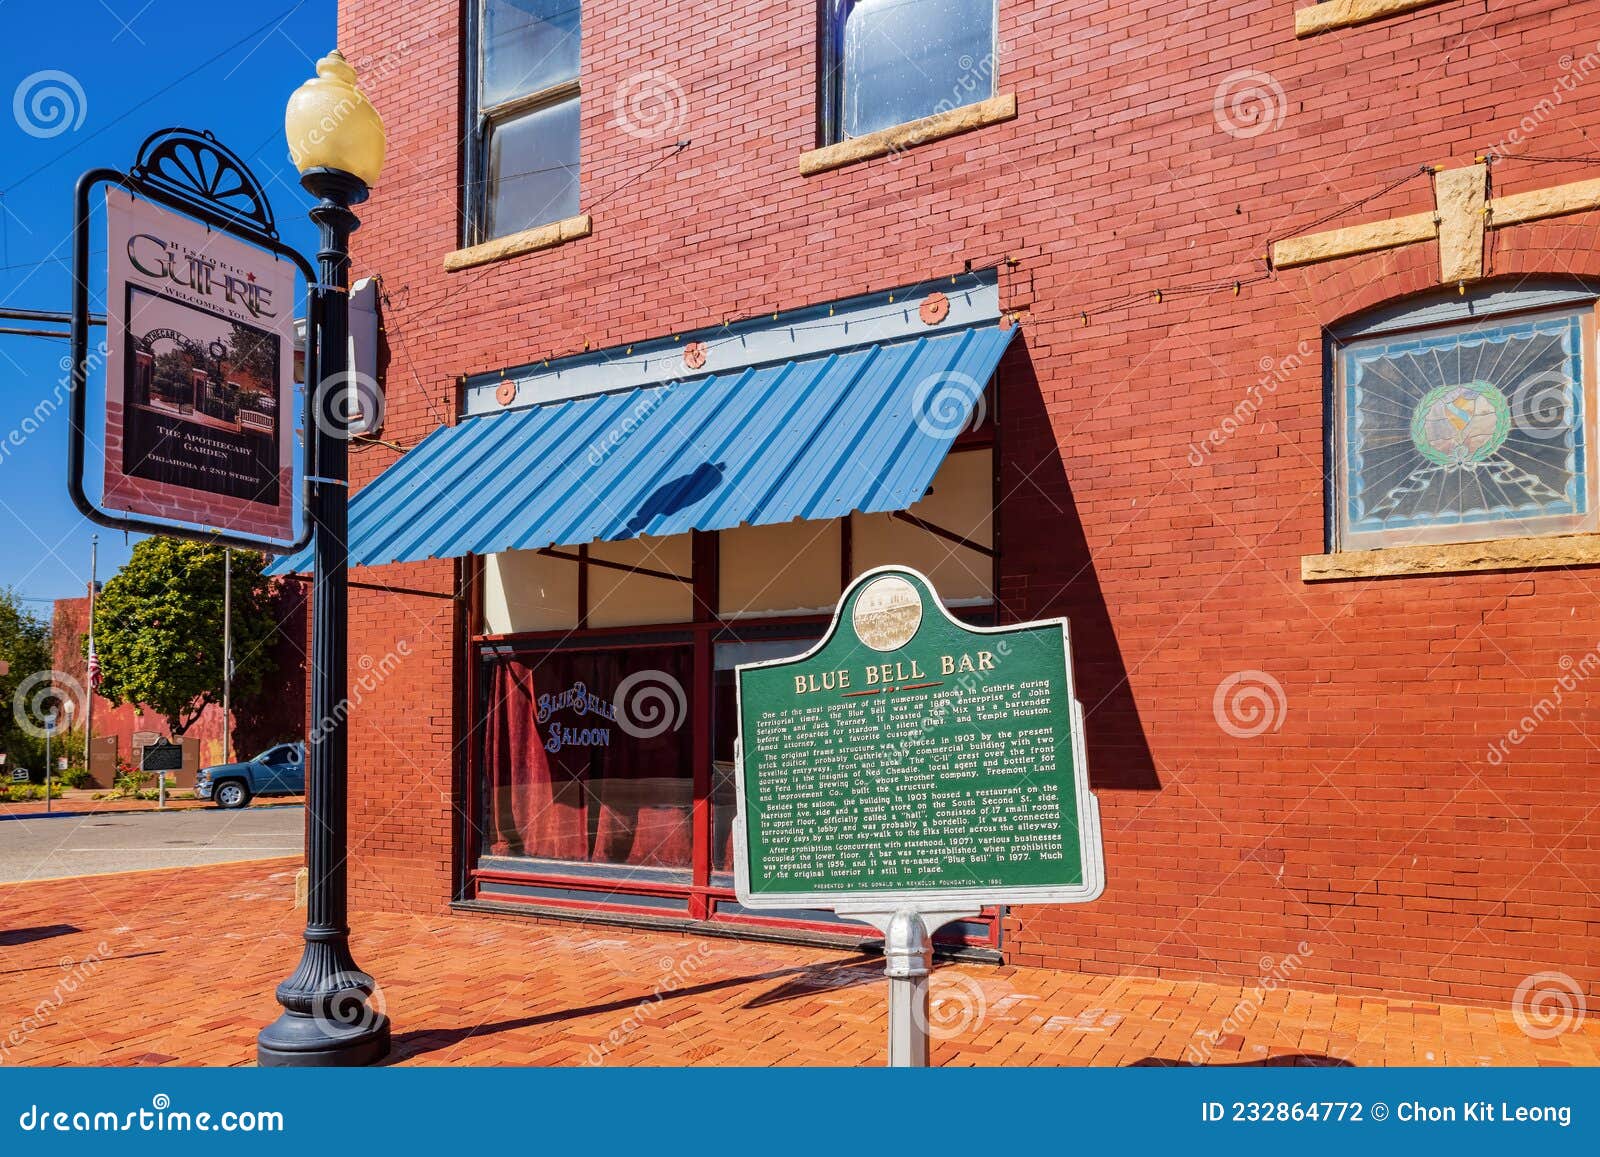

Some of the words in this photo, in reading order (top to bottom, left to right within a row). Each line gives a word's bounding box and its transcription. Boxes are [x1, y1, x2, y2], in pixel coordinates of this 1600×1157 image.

[168, 240, 244, 276] HISTORIC
[127, 233, 278, 319] GUTHRIE
[163, 286, 225, 313] WELCOMES
[227, 307, 249, 321] YOU
[156, 425, 181, 439] THE
[183, 432, 253, 456] APOTHECARY
[183, 442, 228, 459] GARDEN
[147, 453, 198, 471] OKLAHOMA
[199, 464, 207, 472] &
[229, 471, 261, 483] STREET
[794, 670, 851, 694] BLUE
[866, 662, 925, 686] BELL
[941, 651, 995, 675] BAR
[932, 689, 963, 698] saloons
[981, 683, 1014, 693] Guthrie
[1019, 679, 1049, 690] during
[956, 693, 1004, 704] enterprise
[1028, 688, 1050, 697] John
[1004, 697, 1050, 708] bartender
[976, 710, 1007, 720] Temple
[544, 722, 610, 753] SALOON
[954, 733, 975, 742] 1903
[997, 730, 1012, 738] the
[1016, 726, 1052, 738] present
[969, 740, 1005, 751] building
[1010, 737, 1030, 746] with
[1036, 736, 1054, 744] two
[956, 751, 979, 760] crest
[984, 748, 1005, 757] over
[1009, 747, 1024, 755] the
[1029, 744, 1055, 753] front
[953, 760, 977, 770] agent
[1003, 755, 1035, 765] bottler
[1039, 753, 1055, 762] for
[986, 765, 1026, 775] Freemont
[1031, 762, 1055, 772] Land
[930, 790, 960, 799] housed
[975, 785, 1021, 796] restaurant
[951, 798, 975, 807] South
[981, 795, 1013, 805] Second
[935, 807, 976, 817] consisted
[991, 805, 1000, 813] 17
[1004, 804, 1027, 812] small
[1031, 802, 1059, 811] rooms
[1011, 811, 1060, 821] connected
[943, 825, 965, 834] Hotel
[968, 825, 996, 833] across
[999, 823, 1014, 831] the
[977, 836, 1010, 844] various
[1013, 833, 1061, 842] businesses
[982, 844, 1005, 852] when
[1010, 842, 1062, 853] prohibition
[1039, 850, 1062, 859] Much
